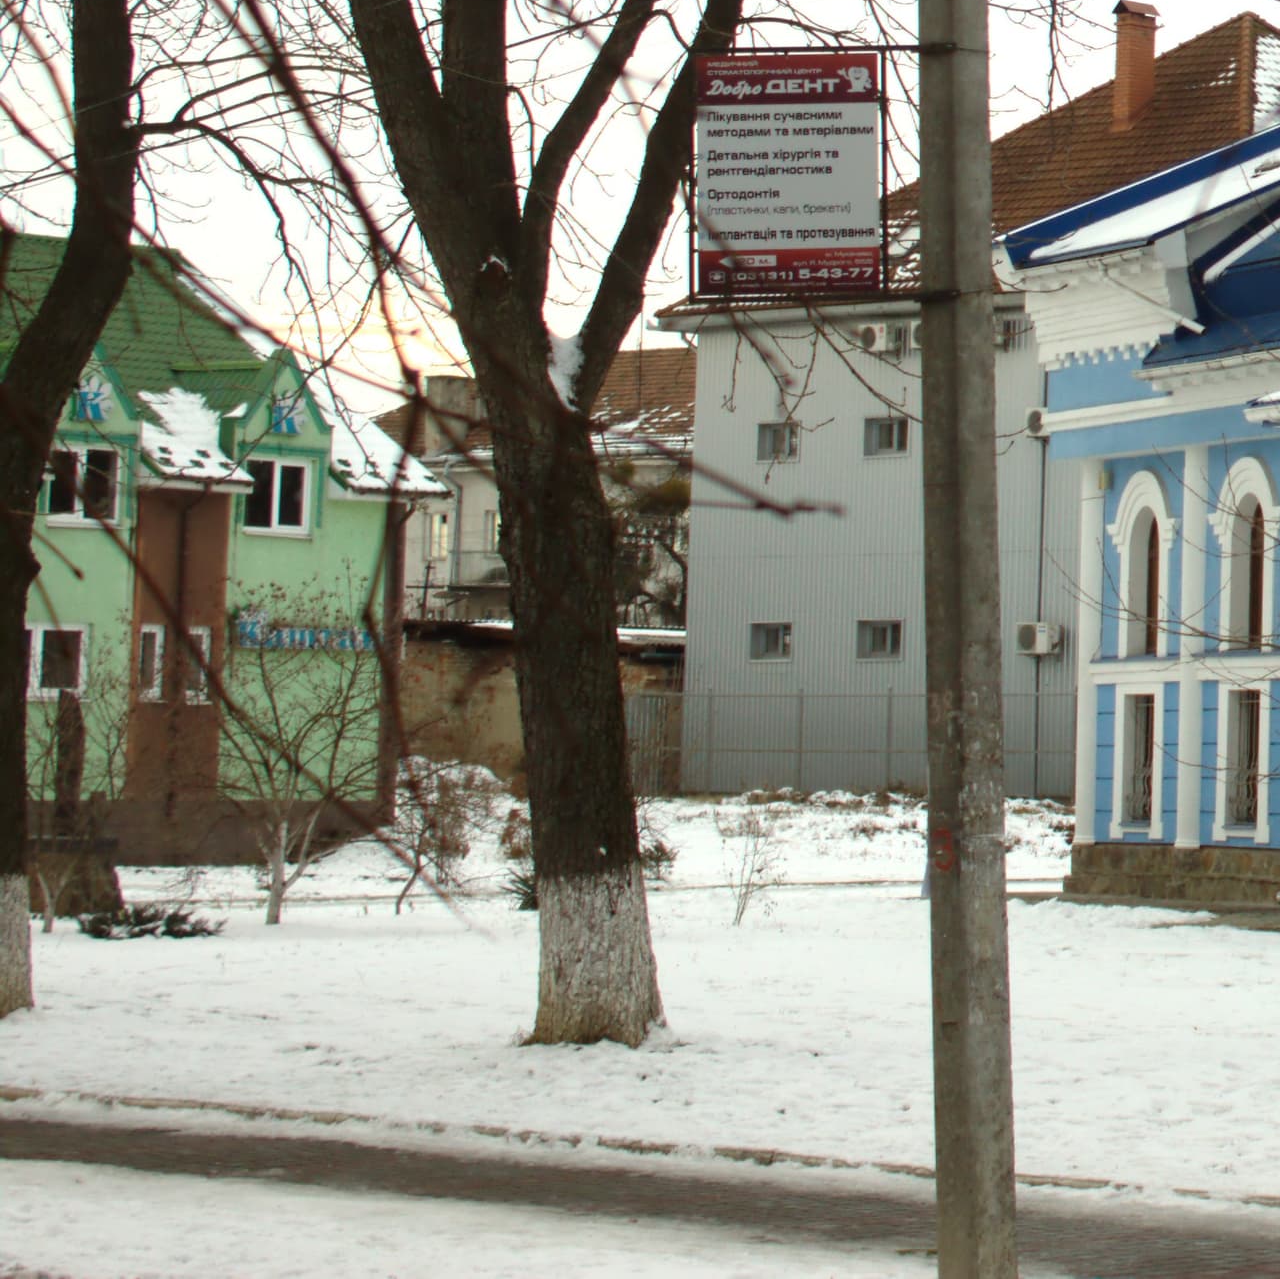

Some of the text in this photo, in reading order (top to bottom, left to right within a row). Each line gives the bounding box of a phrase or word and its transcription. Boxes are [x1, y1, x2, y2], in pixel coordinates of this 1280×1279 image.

[706, 78, 840, 99] Добро ДЕНТ
[707, 111, 843, 124] Лікування сучасними
[707, 125, 875, 138] методами та матеріалами
[707, 148, 840, 162] Детальна хірургія та
[707, 165, 833, 179] рентгендіагностика
[707, 188, 781, 201] Ортодонтія
[780, 229, 794, 239] та
[796, 227, 875, 241] протезування
[799, 267, 874, 279] 5-43-77
